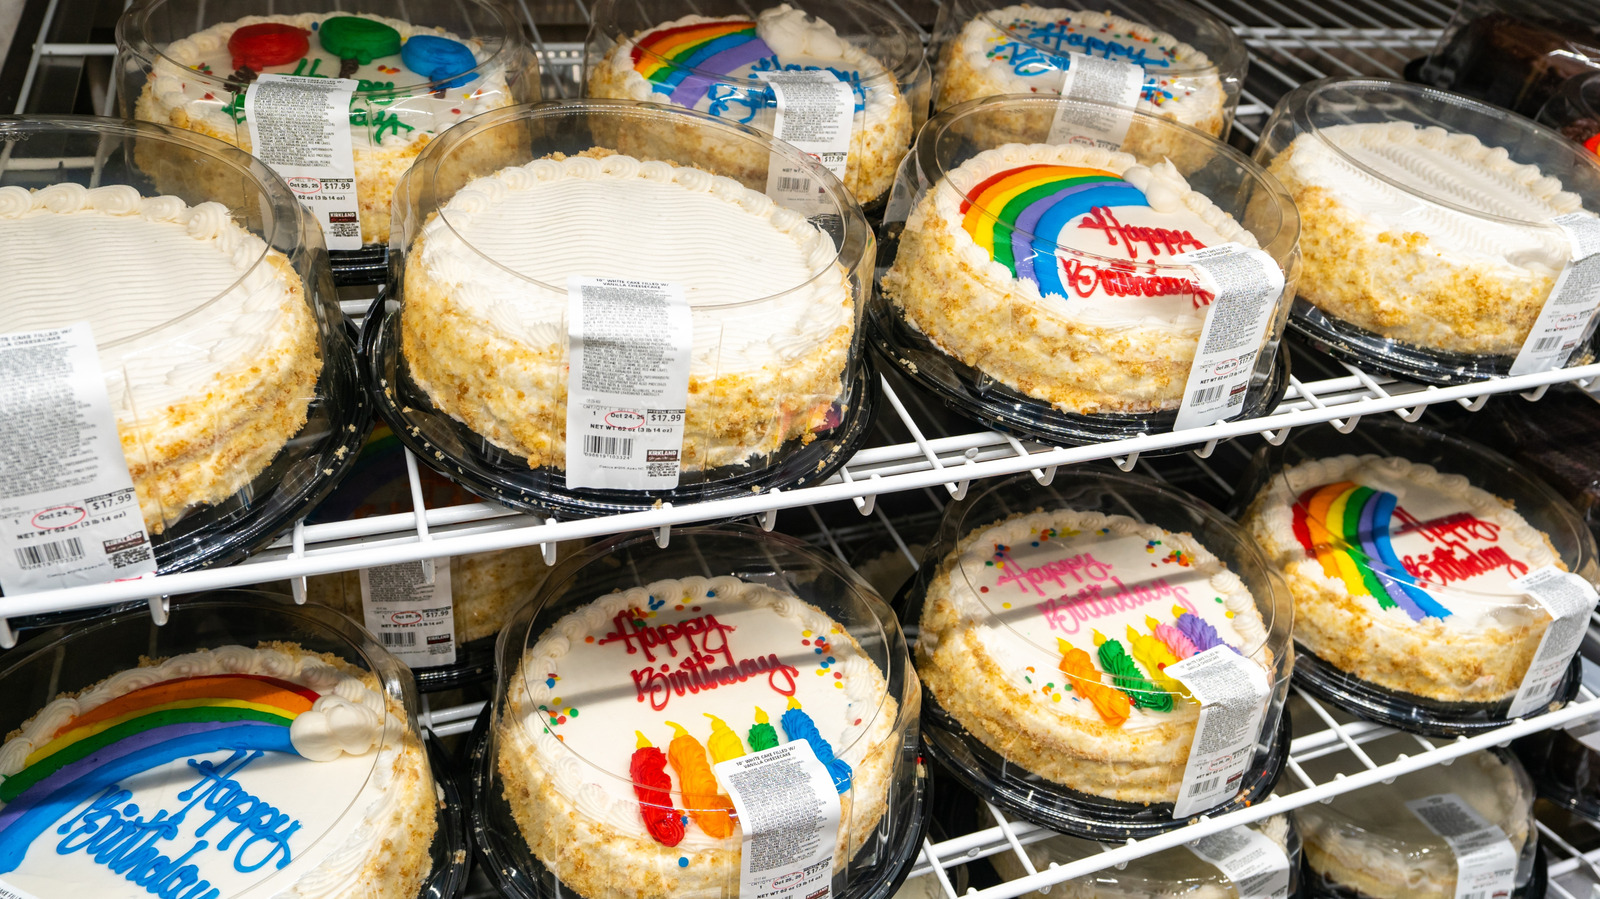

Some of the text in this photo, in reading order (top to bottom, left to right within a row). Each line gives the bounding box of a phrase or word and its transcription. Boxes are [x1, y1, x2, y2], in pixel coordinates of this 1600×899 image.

[1028, 22, 1169, 67] Happy
[1077, 205, 1208, 258] Happy
[651, 414, 681, 422] $17.99
[57, 511, 70, 519] 24,
[93, 493, 132, 511] $17.99
[17, 532, 35, 540] NET
[113, 511, 127, 520] oz)
[1391, 505, 1500, 548] Happy
[996, 549, 1112, 597] Happy
[1400, 540, 1529, 588] Birthday
[1036, 576, 1199, 635] Birthday
[599, 609, 737, 662] Happy
[631, 651, 799, 711] Birthday
[744, 752, 791, 769] VANILLA CHEESECAKE
[168, 748, 304, 873] Happy
[806, 862, 829, 876] $17.99
